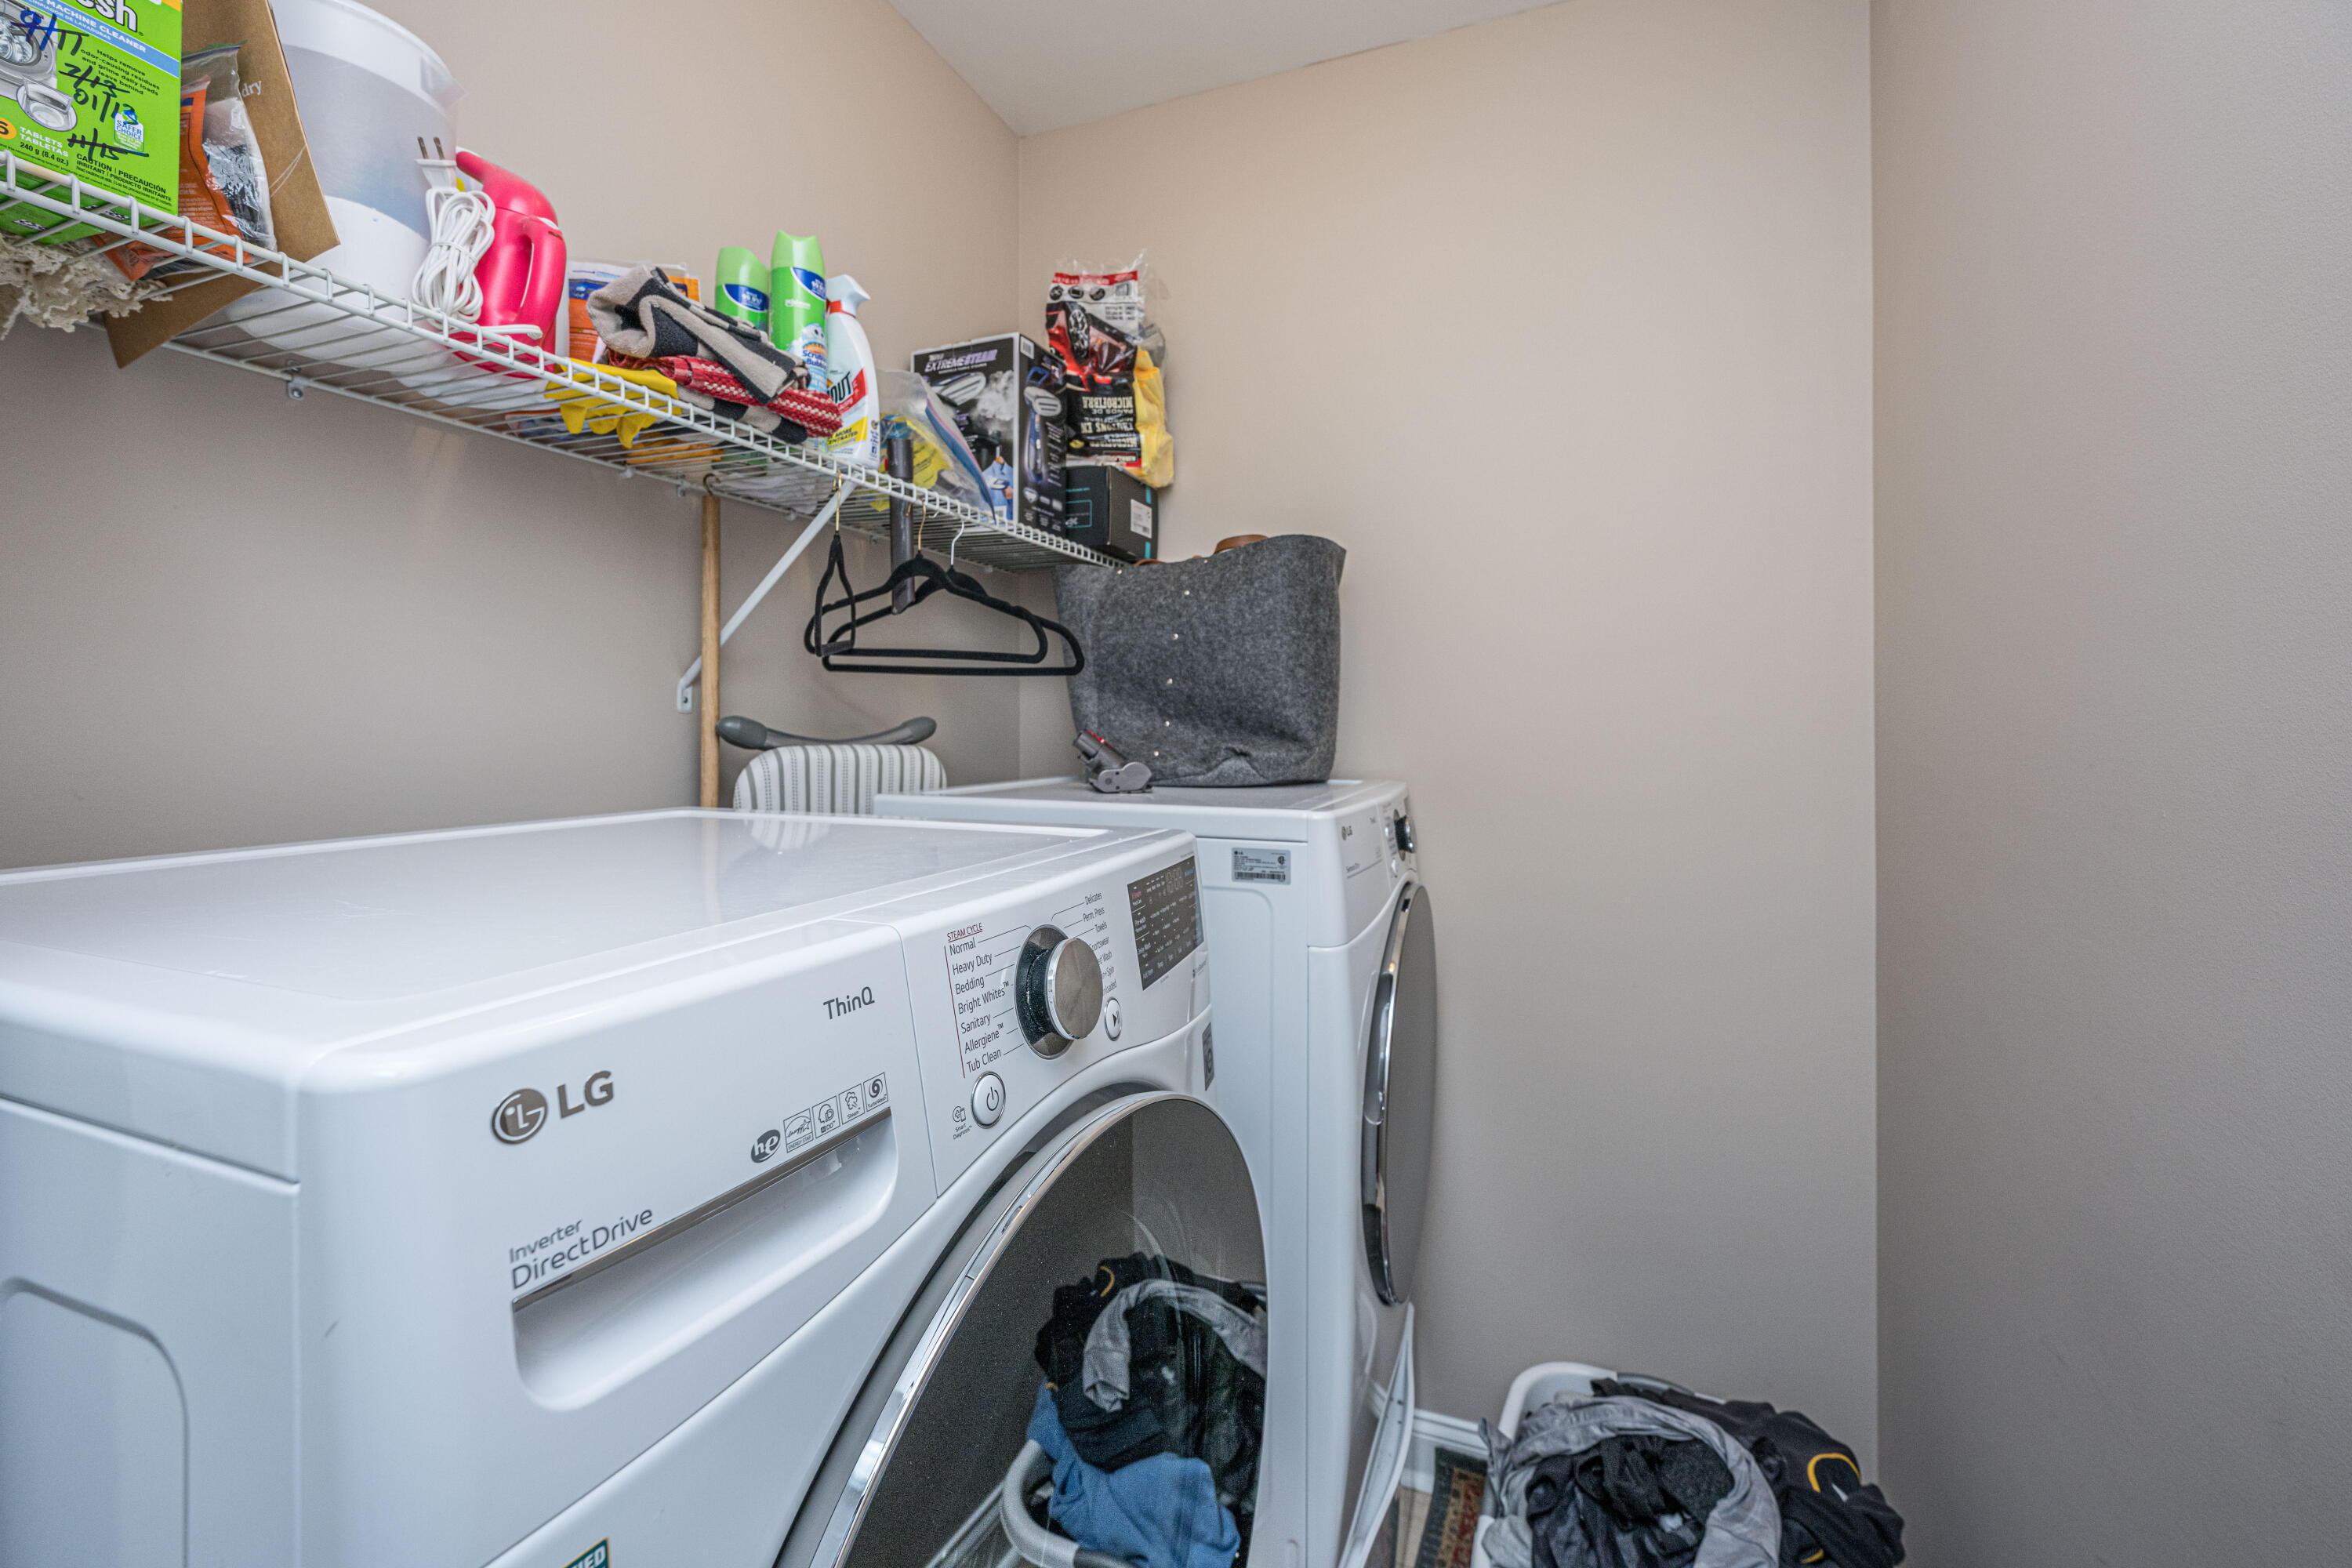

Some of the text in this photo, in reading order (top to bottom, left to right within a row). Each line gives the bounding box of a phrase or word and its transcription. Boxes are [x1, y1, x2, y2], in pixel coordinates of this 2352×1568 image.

[47, 0, 147, 53] MACHINE CLEANER
[74, 18, 111, 40] LAVADORAS
[81, 49, 160, 90] odor-causing residues
[97, 49, 146, 76] Helps remove
[82, 56, 158, 96] and grime daily loads
[99, 71, 144, 95] leave behind
[20, 126, 63, 147] TABLETS
[117, 120, 142, 135] SAFER
[117, 125, 142, 140] CHOICE
[20, 133, 69, 157] TABLETAS
[20, 142, 33, 151] 240
[42, 151, 56, 160] (8.4
[56, 158, 69, 166] oz.)
[76, 153, 166, 194] CAUTION PRECAUCIÓN
[77, 159, 172, 202] IRRITANT PRODUCTO IRRITANTE
[1082, 396, 1133, 408] MICROFIBRA
[1085, 892, 1102, 905] Delicates
[1094, 907, 1105, 917] Press
[947, 923, 983, 941] STEAM CYCLE
[1094, 921, 1107, 933] Towels
[949, 937, 976, 956] Normal
[1090, 937, 1109, 951] portswear
[953, 953, 993, 975] Heavy Duty
[955, 977, 985, 995] Bedding
[1103, 978, 1117, 996] nloaded
[823, 986, 875, 1019] ThinQ
[958, 997, 982, 1014] Bright
[960, 1014, 991, 1034] Sanitary
[967, 1049, 1002, 1073] Tub Clean
[557, 1070, 614, 1119] LG
[955, 1123, 966, 1132] Smart
[802, 1134, 811, 1143] STAR
[510, 1219, 583, 1263] Inverter
